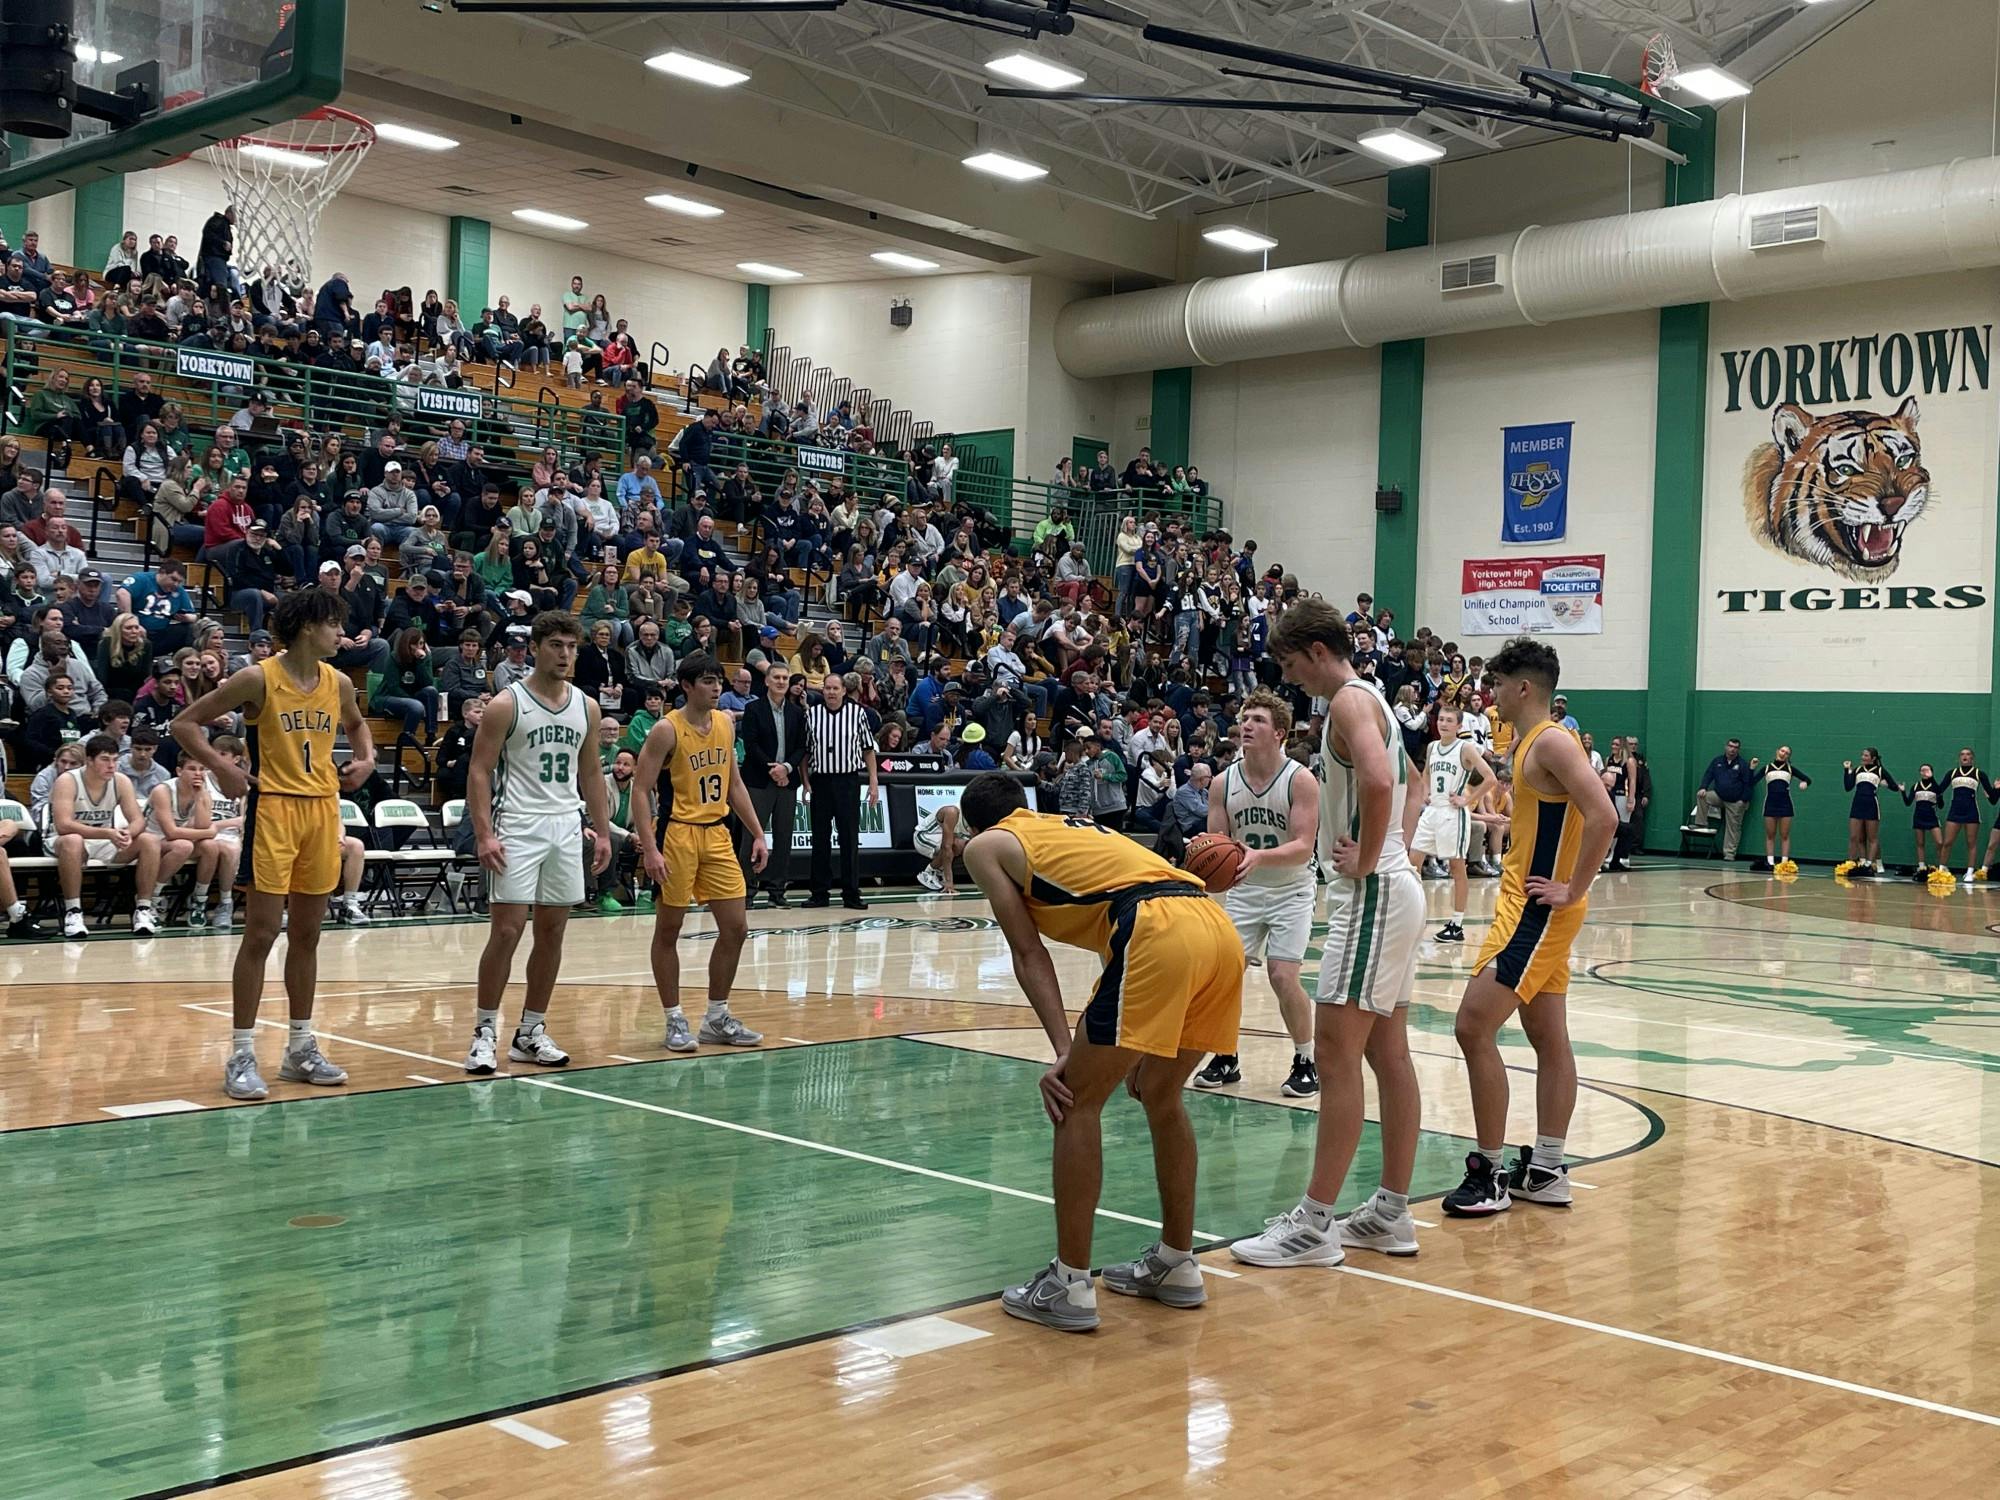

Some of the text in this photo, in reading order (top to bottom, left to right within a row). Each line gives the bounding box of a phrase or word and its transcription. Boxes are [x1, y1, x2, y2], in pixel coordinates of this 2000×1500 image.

[180, 354, 251, 380] YORKTOWN
[1720, 324, 1993, 412] YORKTOWN
[420, 391, 480, 414] VISITORS
[1510, 437, 1565, 454] MEMBER
[800, 451, 843, 470] VISITORS
[1513, 521, 1554, 534] Est. 1903
[1472, 568, 1534, 579] Yorktown High
[1478, 579, 1526, 590] High School
[1544, 582, 1597, 592] TOGETHER
[1464, 598, 1546, 611] Unified Champion
[1717, 585, 1986, 613] TIGERS
[1488, 614, 1520, 626] School
[280, 710, 331, 734] DELTA
[526, 724, 582, 749] TIGERS
[303, 740, 312, 774] 1
[890, 760, 906, 770] POSS
[538, 751, 570, 783] 33
[1429, 761, 1458, 776] TIGERS
[699, 774, 722, 804] 13
[917, 788, 935, 796] HOME
[1436, 776, 1445, 793] 3
[1234, 806, 1287, 831] TIGERS
